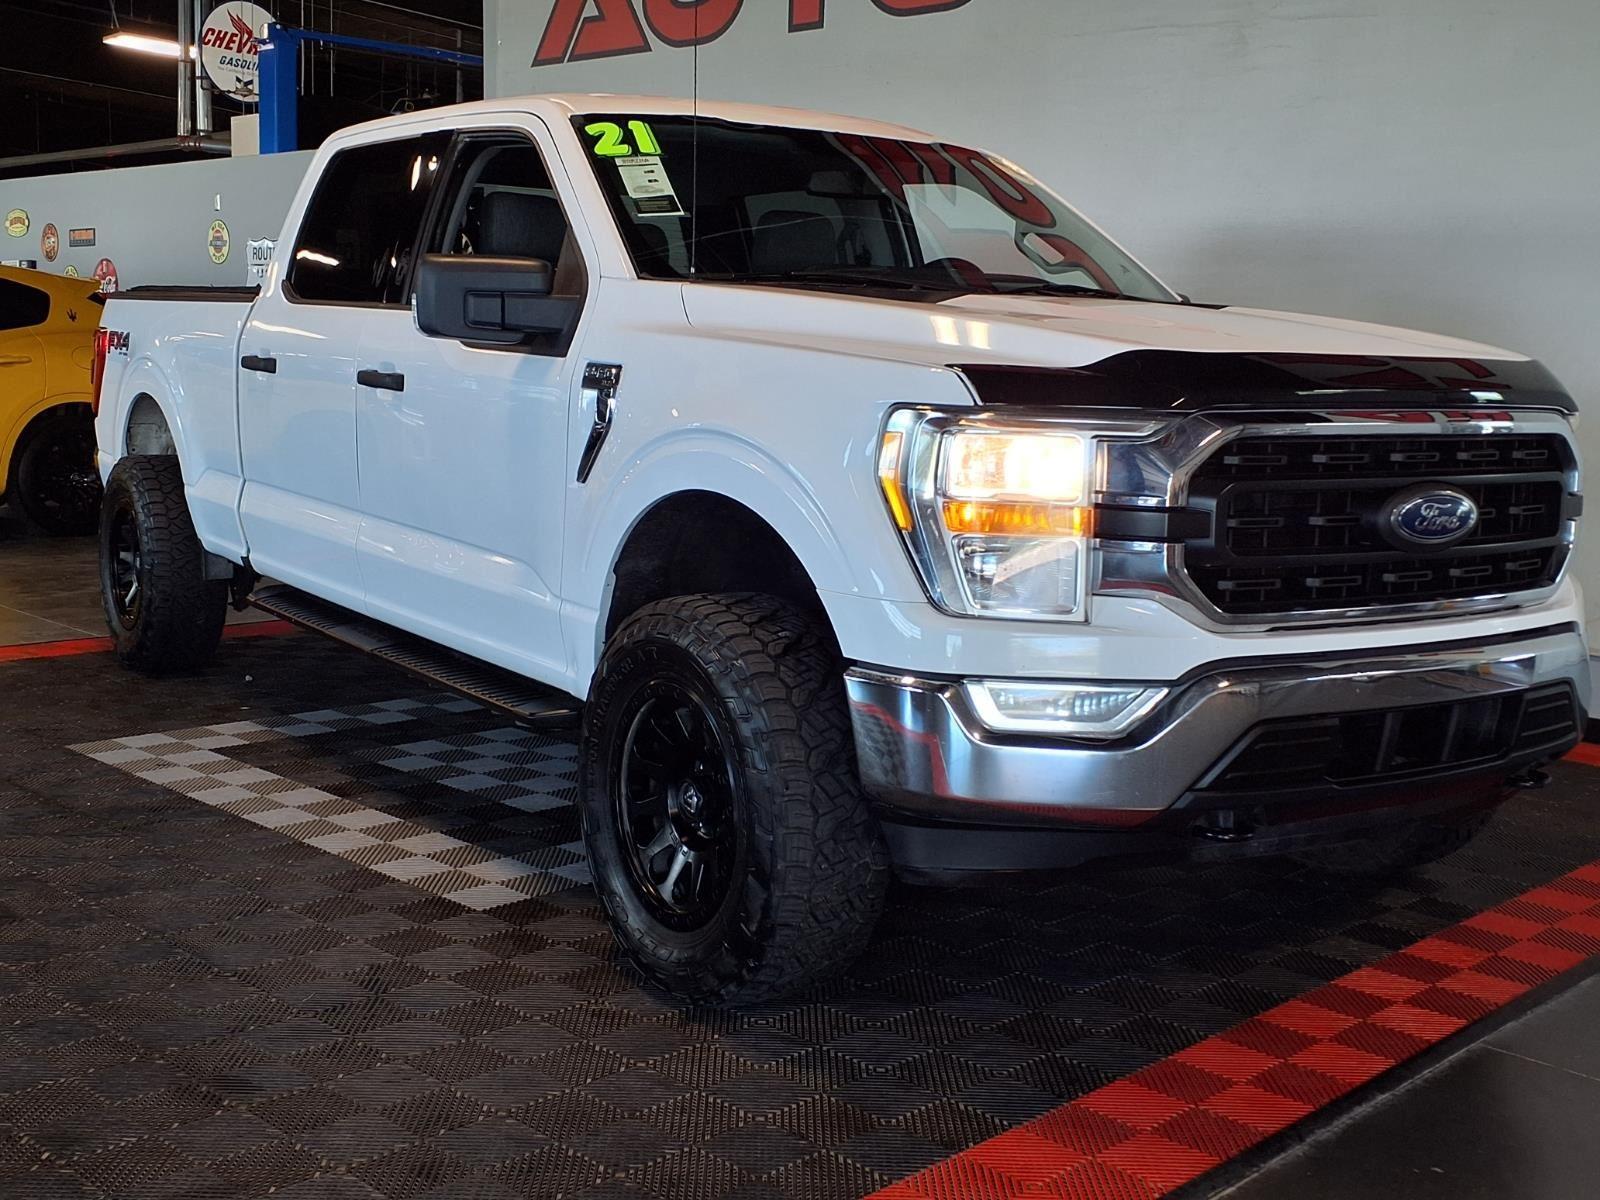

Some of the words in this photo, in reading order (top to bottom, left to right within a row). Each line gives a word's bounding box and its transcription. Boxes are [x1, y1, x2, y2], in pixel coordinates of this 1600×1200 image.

[219, 55, 259, 72] GASOLI
[584, 120, 662, 156] 21
[252, 246, 275, 261] ROUT
[107, 330, 130, 354] FX4
[1414, 502, 1461, 531] Ford
